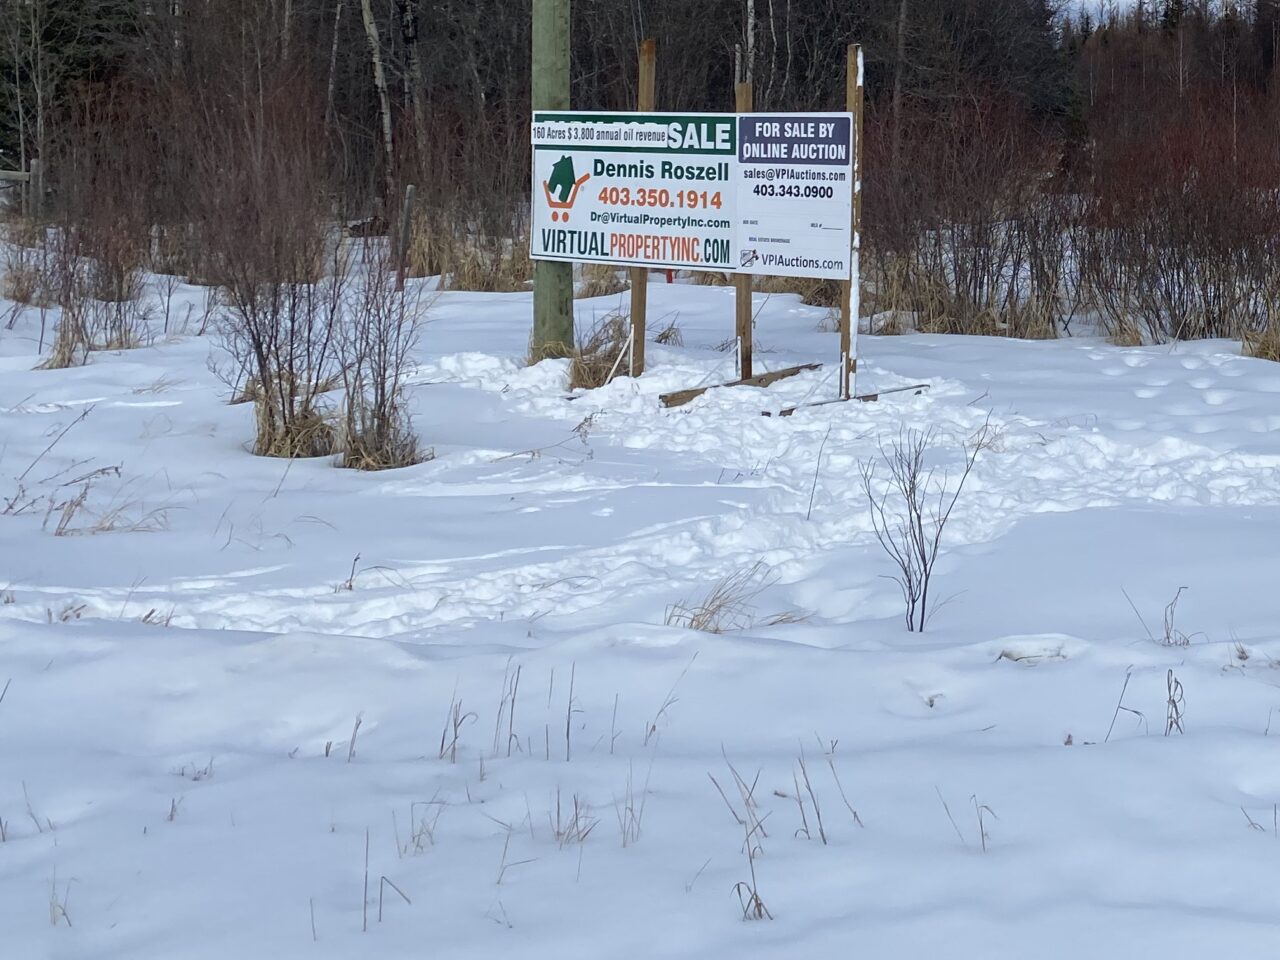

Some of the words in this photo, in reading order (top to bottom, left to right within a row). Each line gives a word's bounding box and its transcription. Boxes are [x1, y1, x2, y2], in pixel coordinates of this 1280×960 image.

[533, 126, 545, 139] 160
[547, 126, 566, 140] Acres
[596, 128, 621, 141] annual
[624, 128, 634, 141] oil
[635, 131, 666, 142] revenue
[668, 122, 731, 150] SALE
[755, 122, 780, 138] FOR
[784, 122, 815, 138] SALE
[819, 123, 835, 138] BY
[743, 142, 788, 159] ONLINE
[791, 143, 846, 160] AUCTION
[593, 158, 655, 179] Dennis
[661, 160, 729, 181] Roszell
[743, 168, 846, 182] sales@VPIAuctions.com
[598, 186, 722, 210] 403.350.1914
[753, 184, 834, 199] 403.343.0900
[590, 211, 731, 229] Dr@VirtualPropertyInc.com
[541, 228, 730, 264] VIRTUALPROPERTYINC.COM
[761, 253, 844, 271] VPIAuctions.com
